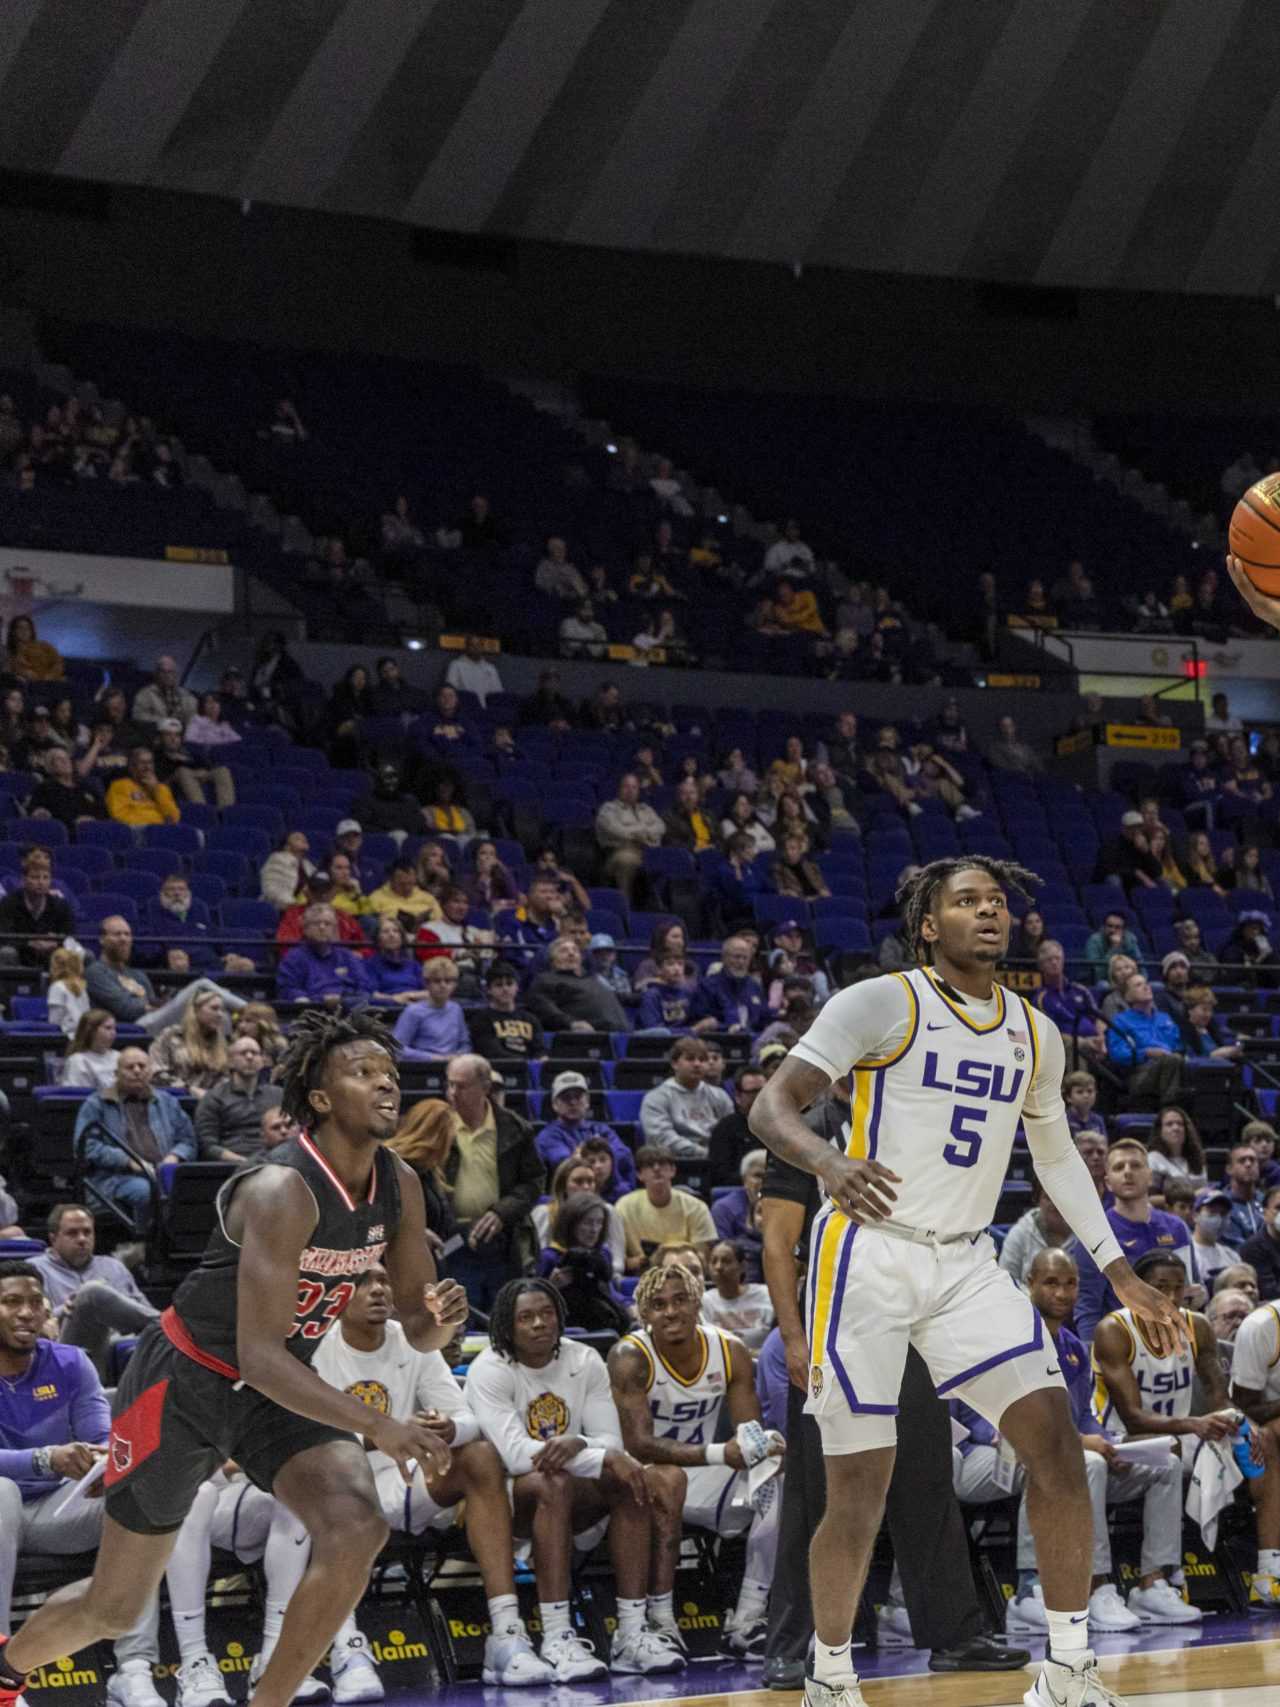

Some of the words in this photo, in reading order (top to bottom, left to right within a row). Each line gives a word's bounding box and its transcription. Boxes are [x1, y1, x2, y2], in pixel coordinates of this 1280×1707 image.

[493, 1020, 533, 1040] LSU
[922, 1051, 1024, 1102] LSU
[943, 1105, 987, 1167] 5
[1137, 1367, 1190, 1394] LSU
[650, 1396, 721, 1422] LSU
